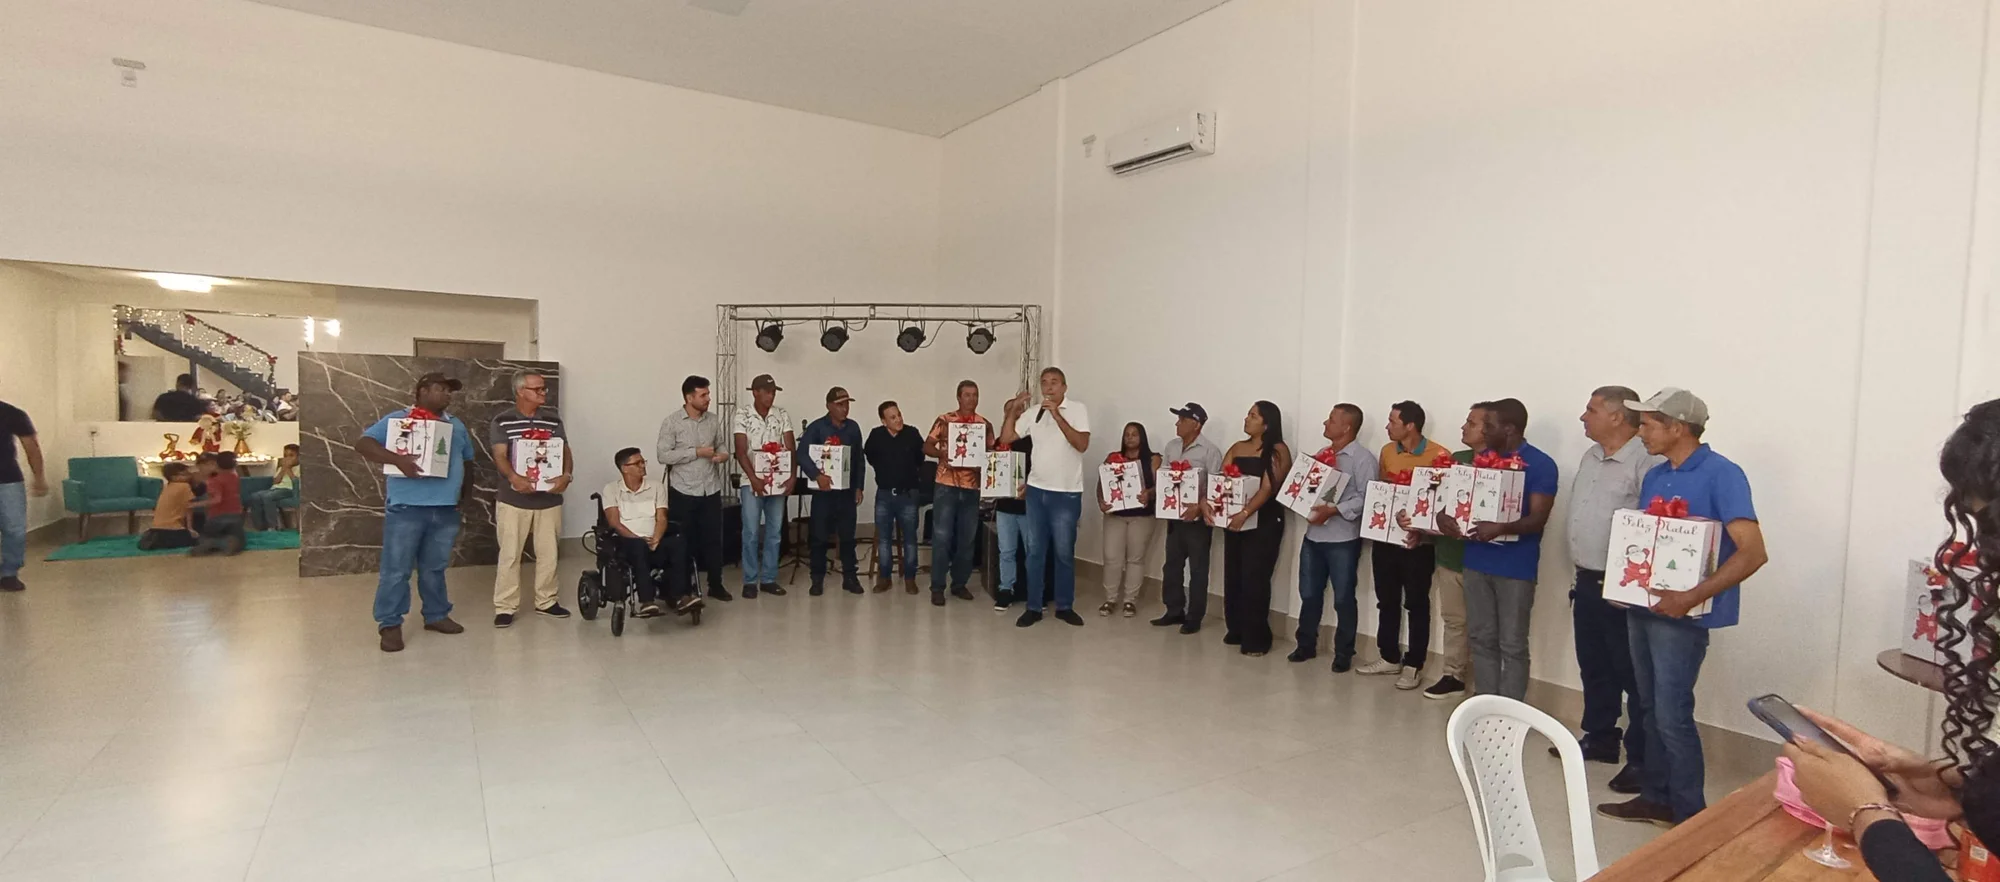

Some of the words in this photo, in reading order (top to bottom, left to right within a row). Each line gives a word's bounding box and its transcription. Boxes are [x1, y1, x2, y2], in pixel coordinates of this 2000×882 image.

[1455, 467, 1472, 480] Feliz
[1622, 514, 1651, 533] Feliz
[1655, 519, 1698, 536] Natal
